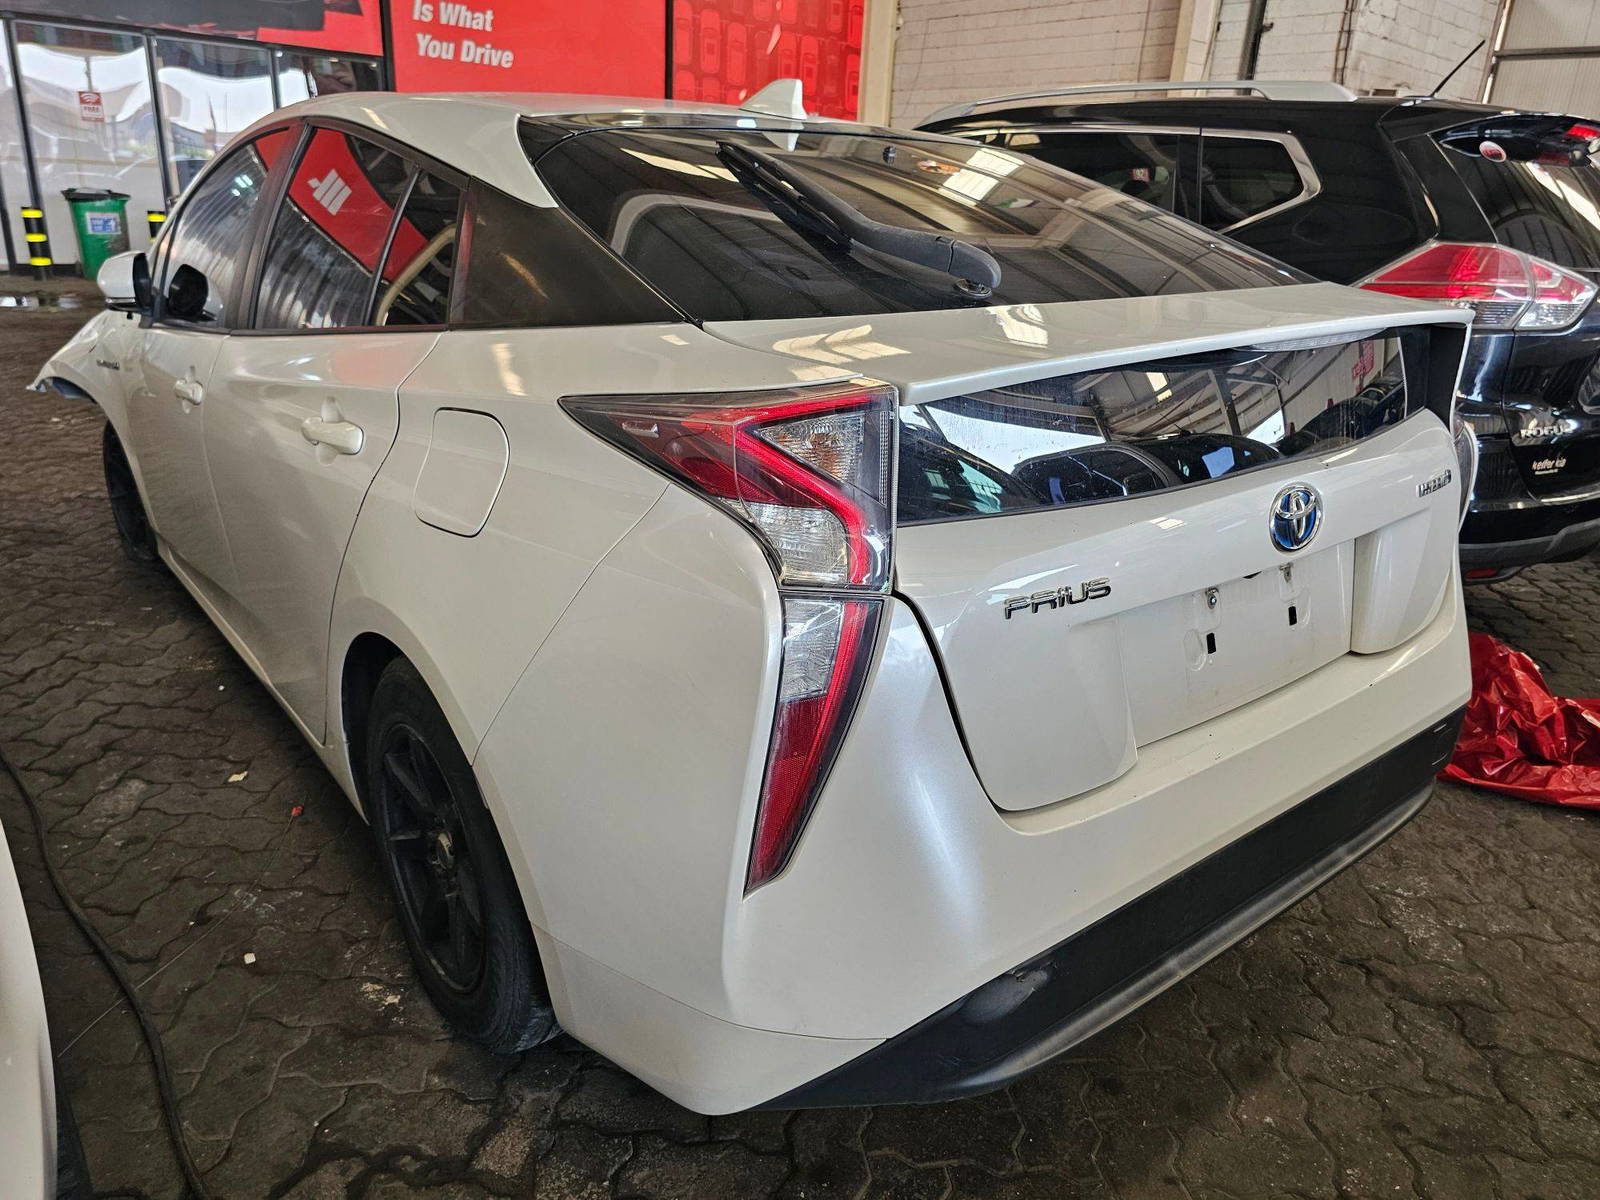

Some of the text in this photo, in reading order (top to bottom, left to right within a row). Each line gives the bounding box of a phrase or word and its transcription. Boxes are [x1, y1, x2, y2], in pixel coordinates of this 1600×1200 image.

[412, 0, 494, 32] Is What
[416, 33, 514, 68] You Drive
